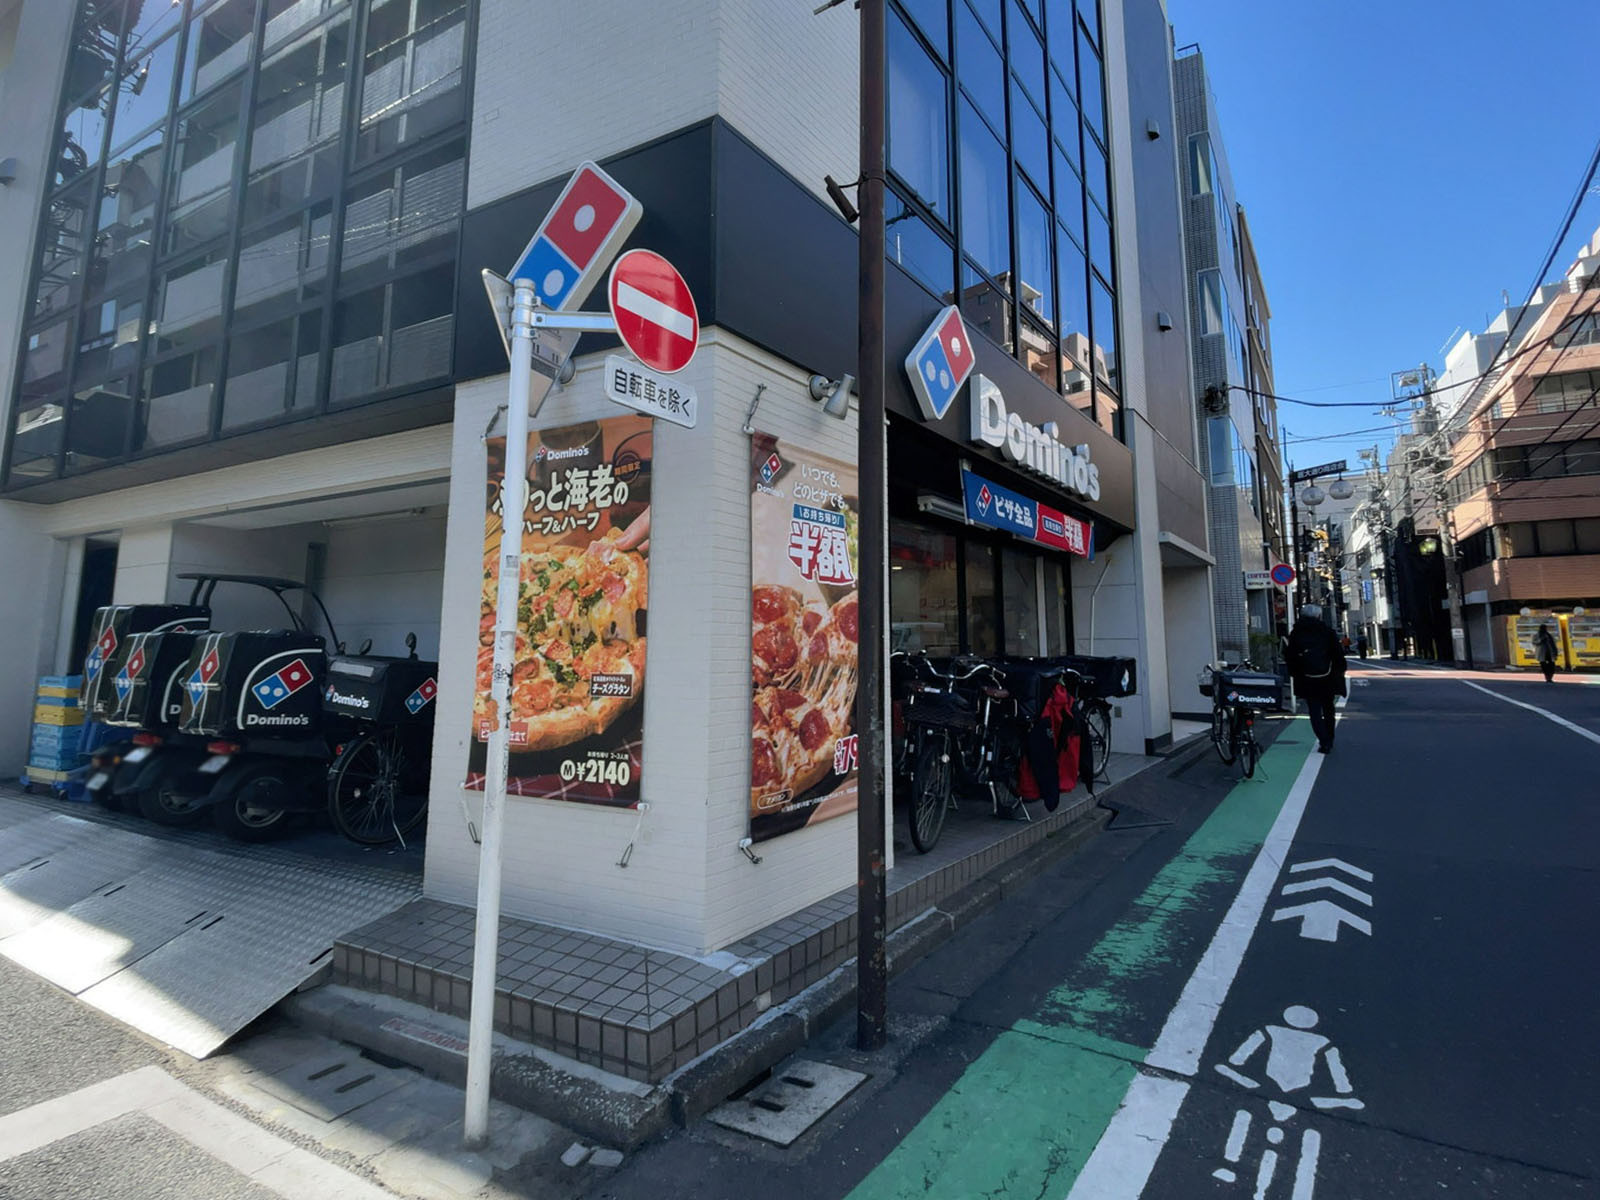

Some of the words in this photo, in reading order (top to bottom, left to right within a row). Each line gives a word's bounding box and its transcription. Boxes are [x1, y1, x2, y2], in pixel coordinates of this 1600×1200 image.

[614, 367, 690, 417] 自転車を除く
[970, 373, 1100, 501] Domino's
[547, 446, 590, 461] Domino's
[994, 494, 1034, 529] ピザ全品
[788, 521, 855, 583] 半額
[592, 682, 630, 695] チーズグラタン
[1238, 694, 1276, 704] Domino's
[332, 692, 370, 709] Domino's
[247, 713, 309, 726] Domino's
[577, 759, 630, 786] ¥2140
